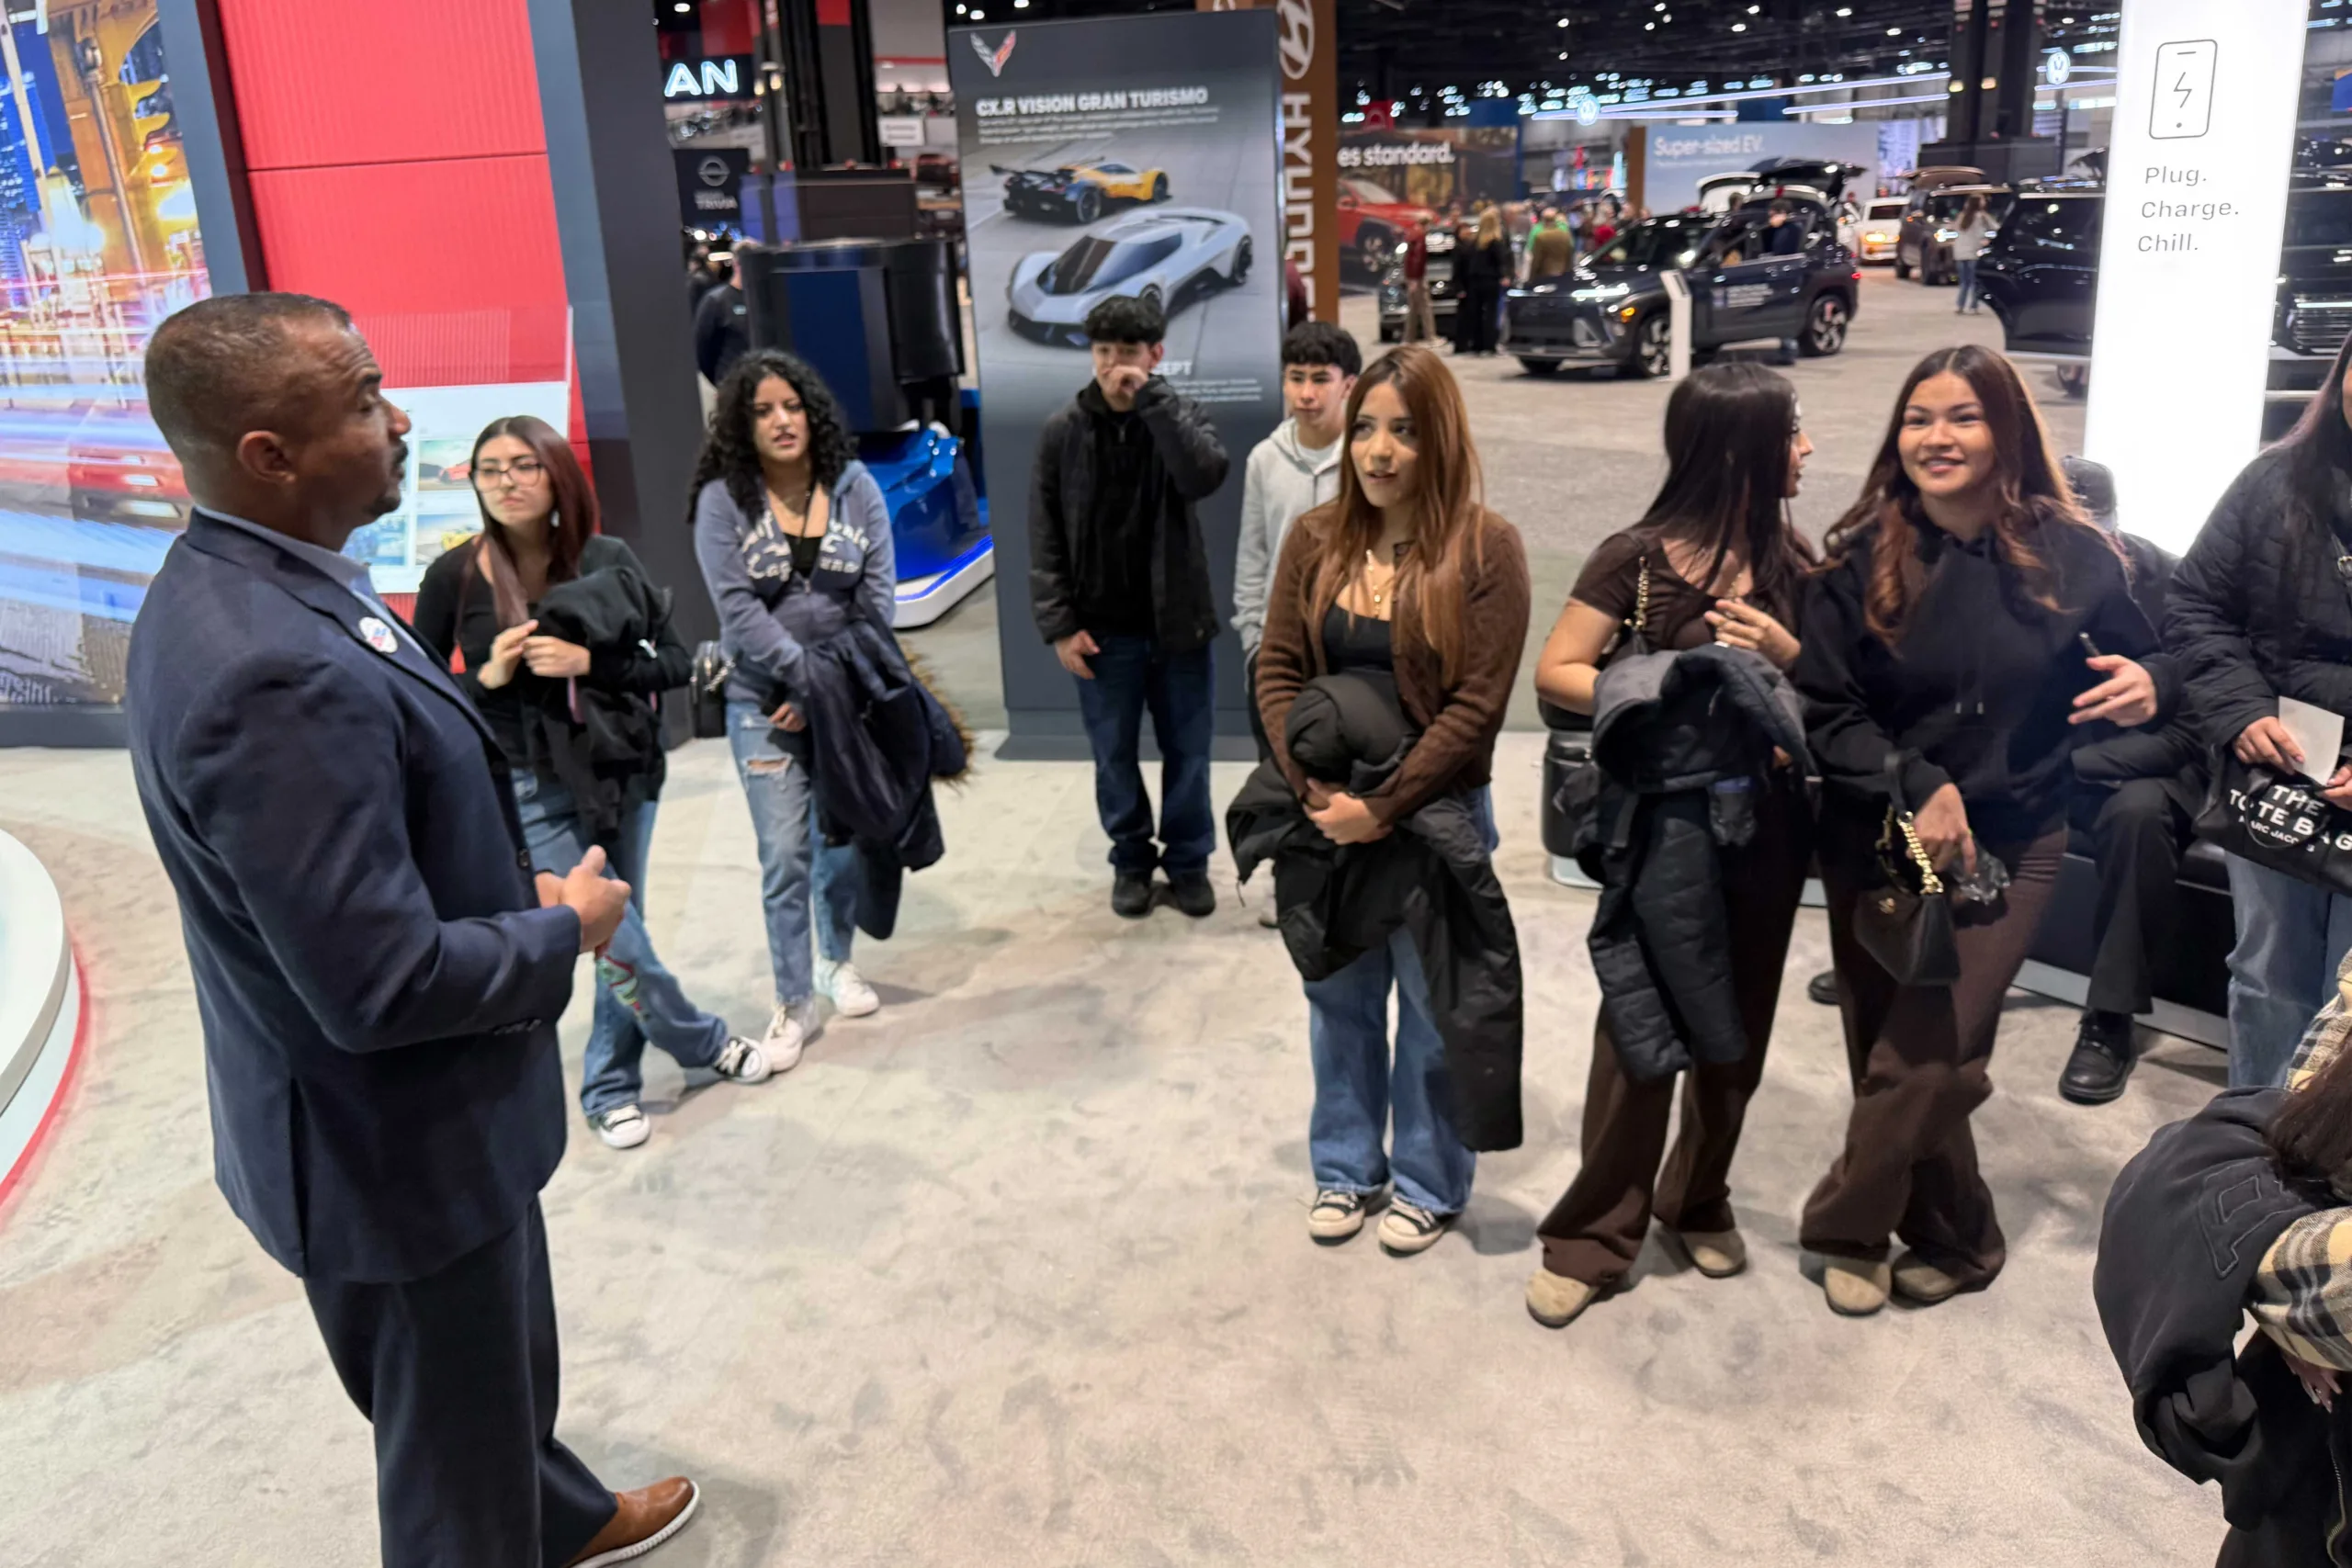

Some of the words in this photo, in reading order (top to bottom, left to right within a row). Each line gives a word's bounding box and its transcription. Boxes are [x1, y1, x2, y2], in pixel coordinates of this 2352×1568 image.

[1017, 95, 1076, 115] VISION
[1077, 91, 1127, 111] GRAN
[1128, 86, 1209, 107] TURISMO
[1363, 139, 1456, 166] standard.
[1654, 135, 1740, 159] Super-sized
[2145, 165, 2207, 186] Plug.
[1283, 92, 1316, 323] HYUND
[2142, 200, 2239, 220] Charge.
[2138, 233, 2199, 253] Chill.
[2272, 784, 2325, 817] THE
